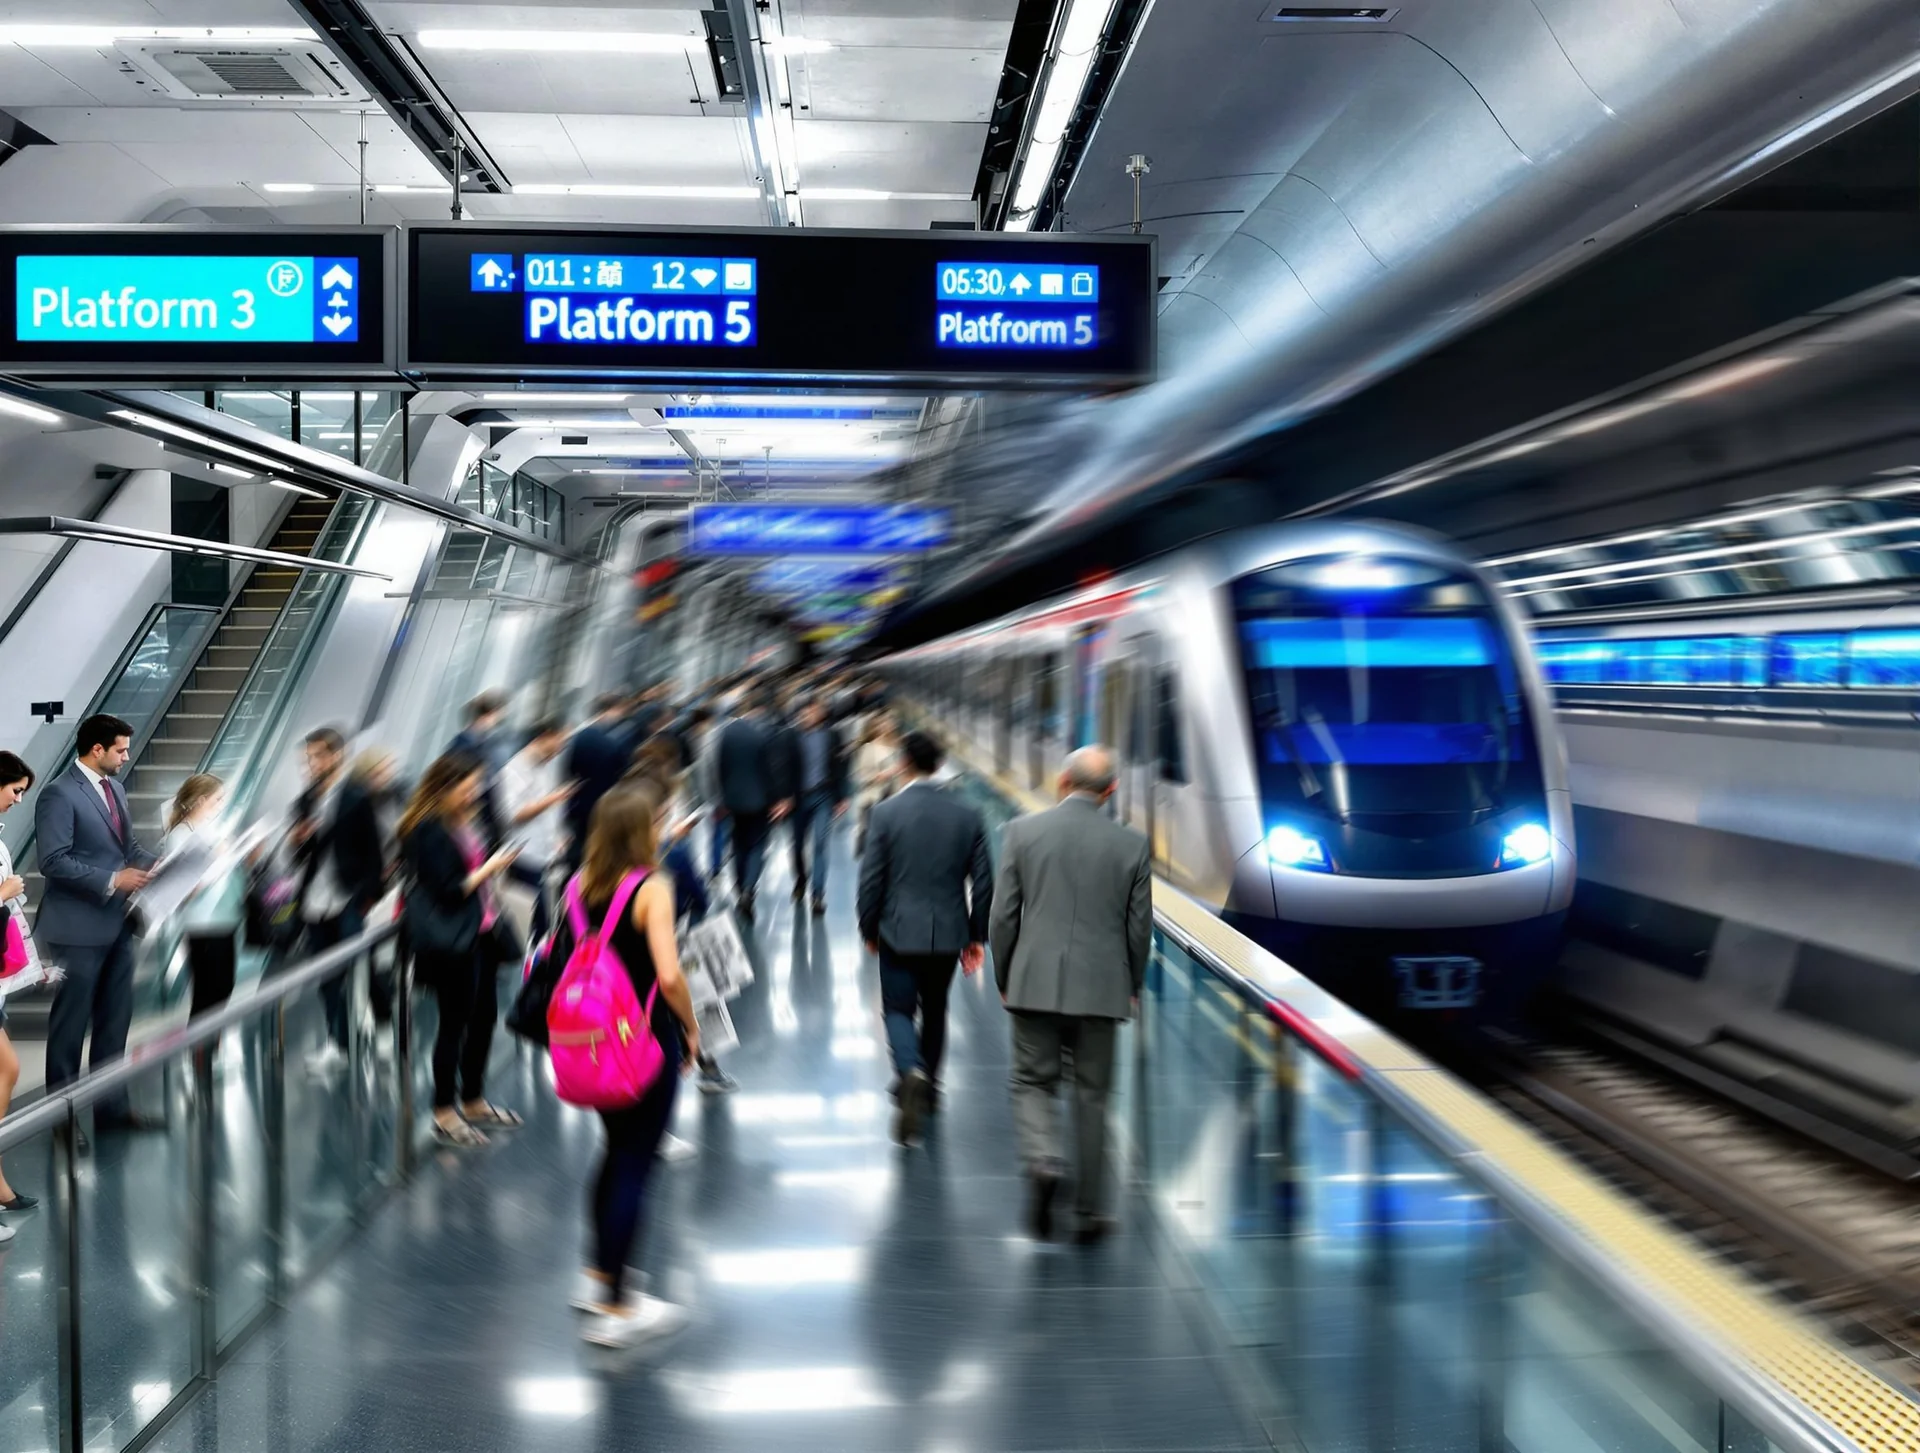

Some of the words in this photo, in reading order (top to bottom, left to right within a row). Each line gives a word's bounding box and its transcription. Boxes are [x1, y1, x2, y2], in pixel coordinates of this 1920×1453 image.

[652, 261, 685, 290] 12
[32, 285, 218, 329] Platform
[230, 288, 256, 330] 3
[530, 296, 713, 341] Platform
[725, 300, 752, 343] 5
[939, 311, 1068, 344] Platfrorm
[1074, 315, 1093, 345] 5
